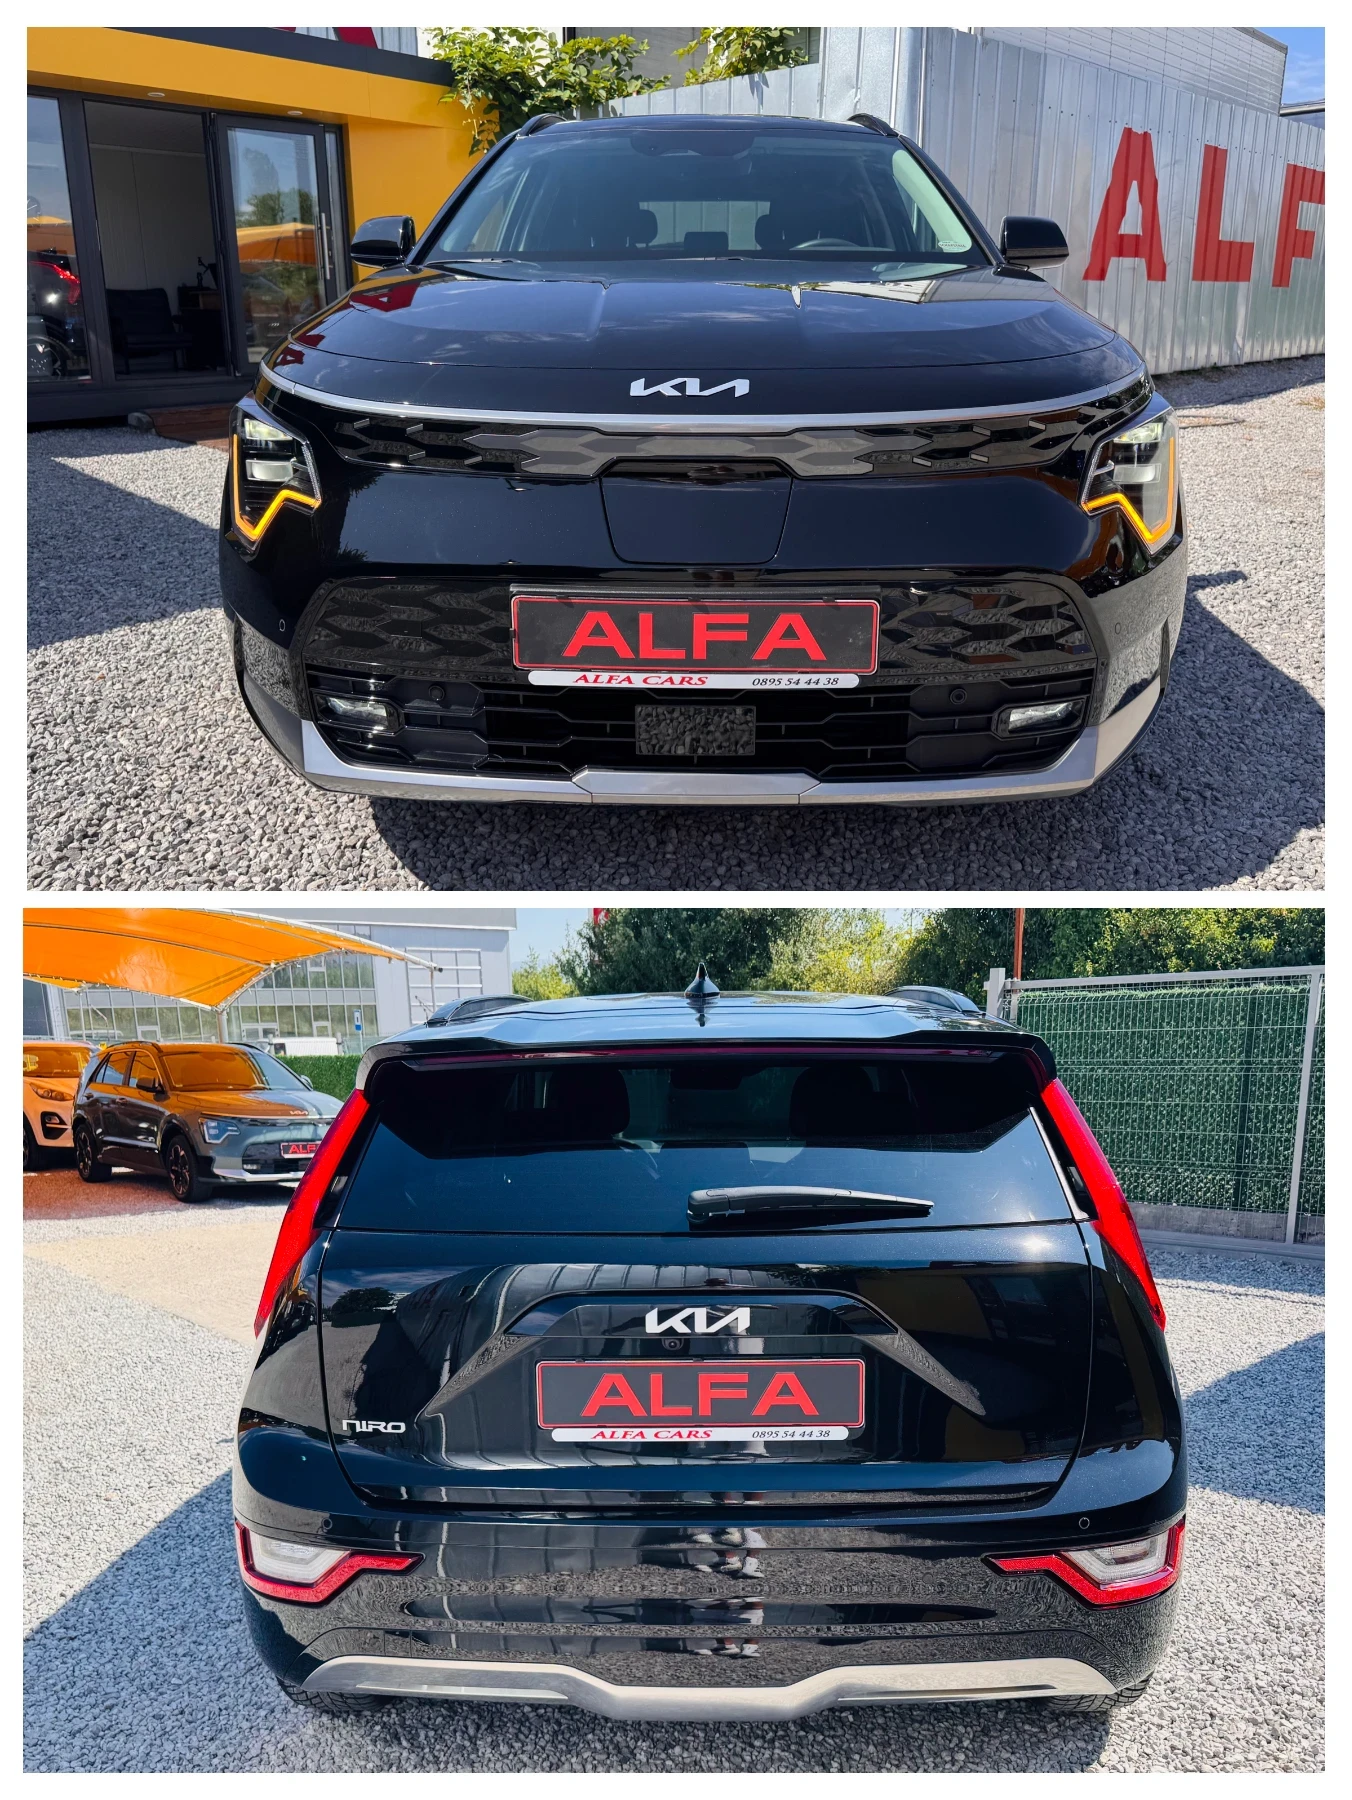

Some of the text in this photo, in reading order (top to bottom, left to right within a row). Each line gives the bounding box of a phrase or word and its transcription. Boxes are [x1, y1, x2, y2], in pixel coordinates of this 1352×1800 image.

[629, 377, 750, 398] KIA
[562, 610, 827, 661] ALFA
[573, 673, 709, 686] ALFA CARS
[752, 677, 840, 687] 0895 54 44 38
[645, 1307, 750, 1334] KIA
[580, 1372, 820, 1417] ALFA
[342, 1419, 406, 1434] NIRO
[752, 1429, 831, 1439] 0895 54 44 38
[590, 1430, 713, 1440] ALFA CARS
